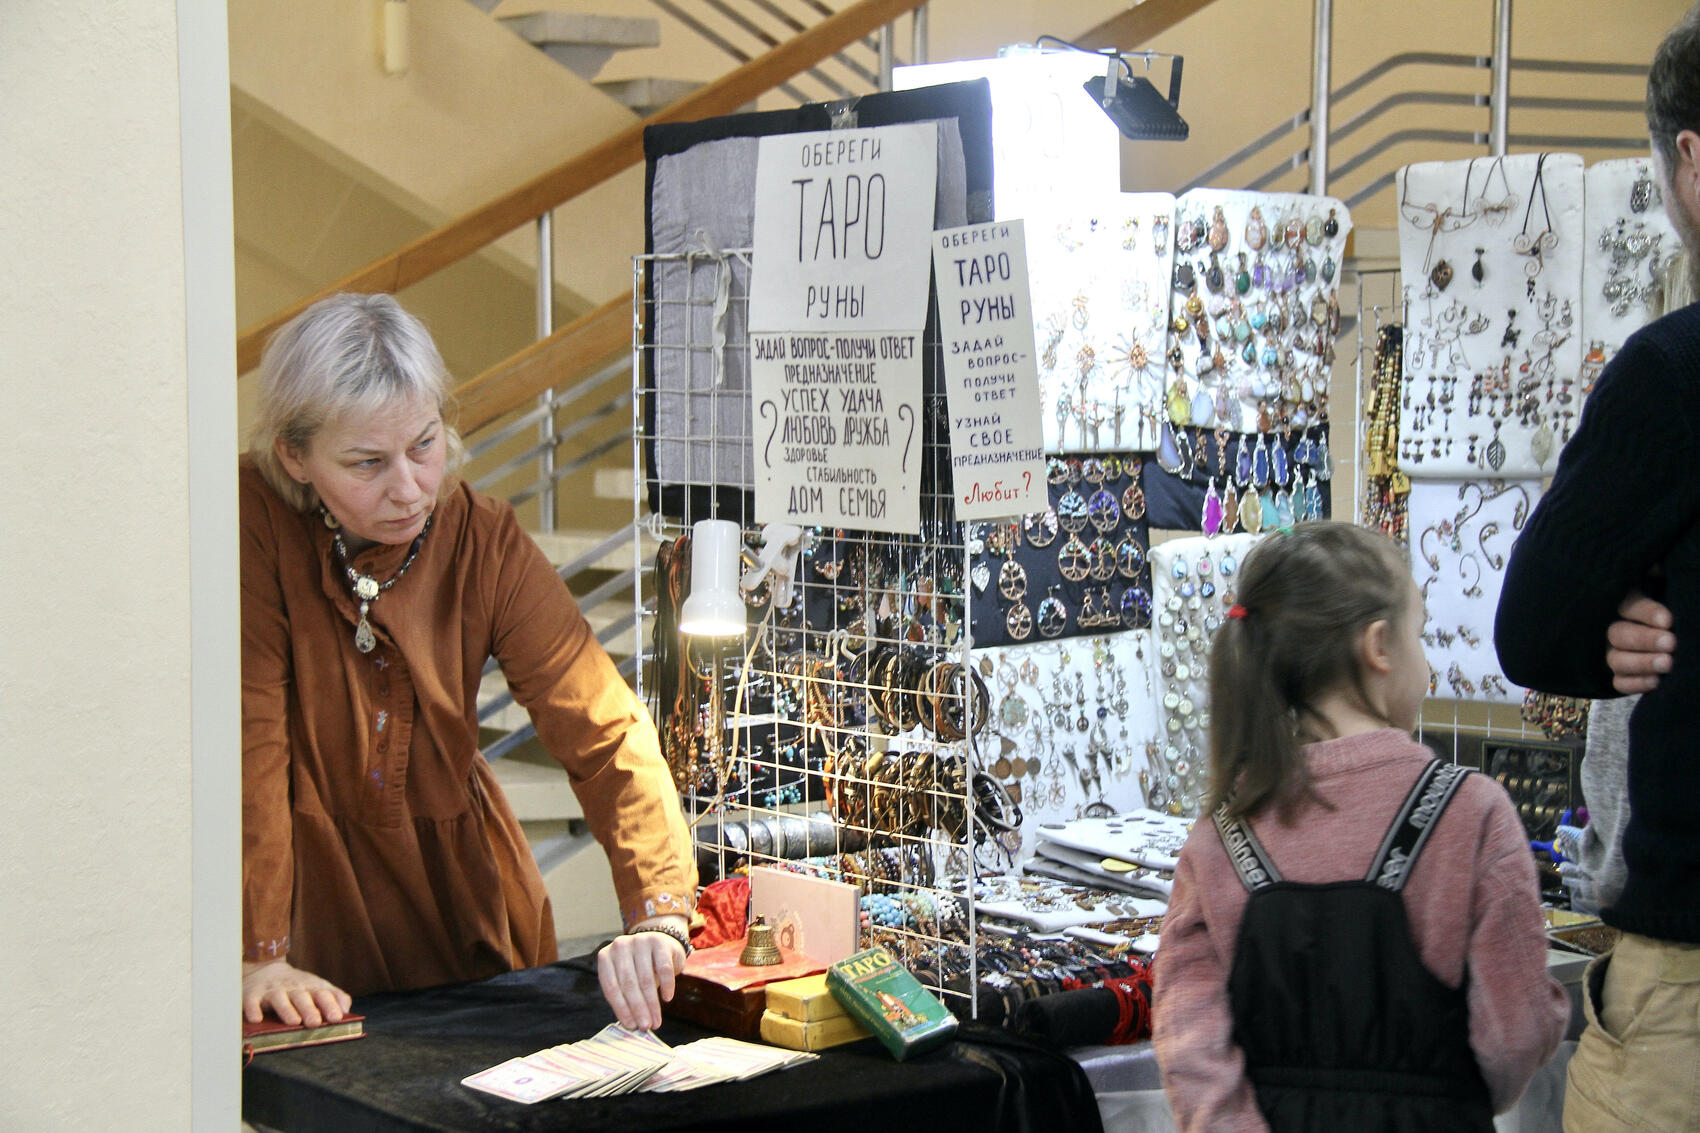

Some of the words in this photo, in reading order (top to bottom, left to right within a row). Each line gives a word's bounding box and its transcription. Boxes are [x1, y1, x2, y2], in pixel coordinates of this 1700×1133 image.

[801, 138, 881, 168] ОБЕРЕГИ
[791, 173, 886, 262] ТАРО
[942, 227, 1010, 249] ОБЕРЕГИ
[954, 252, 1011, 287] ТАРО
[806, 285, 865, 319] РУНЫ
[960, 295, 1015, 325] РУНЫ
[755, 337, 785, 360] ЗАДАЙ
[880, 335, 915, 359] ОТВЕТ
[951, 336, 1004, 354] ЗАДАЙ
[968, 352, 1028, 369] ВОПРОС-
[784, 362, 877, 385] ПРЕДНАЗНАЧЕНИЕ
[963, 373, 1016, 389] ПОЛУЧИ
[781, 388, 830, 413] УСПЕХ
[839, 388, 884, 415] УДАЧА
[975, 387, 1016, 402] ОТВЕТ
[781, 415, 836, 445] ЛЮБОВЬ
[842, 416, 890, 447] ДРУЖБА
[955, 414, 1001, 430] УЗНАЙ
[970, 428, 1014, 448] СВОЕ
[784, 446, 828, 463] ЗДОРОВЬЕ
[954, 447, 1043, 467] ПРЕДНАЗНАЧЕНИЕ
[806, 465, 877, 485] СТАБИЛЬНОСТЬ
[787, 485, 823, 515] ДОМ
[840, 487, 887, 519] СЕМЬЯ
[840, 952, 891, 979] ТАРО
